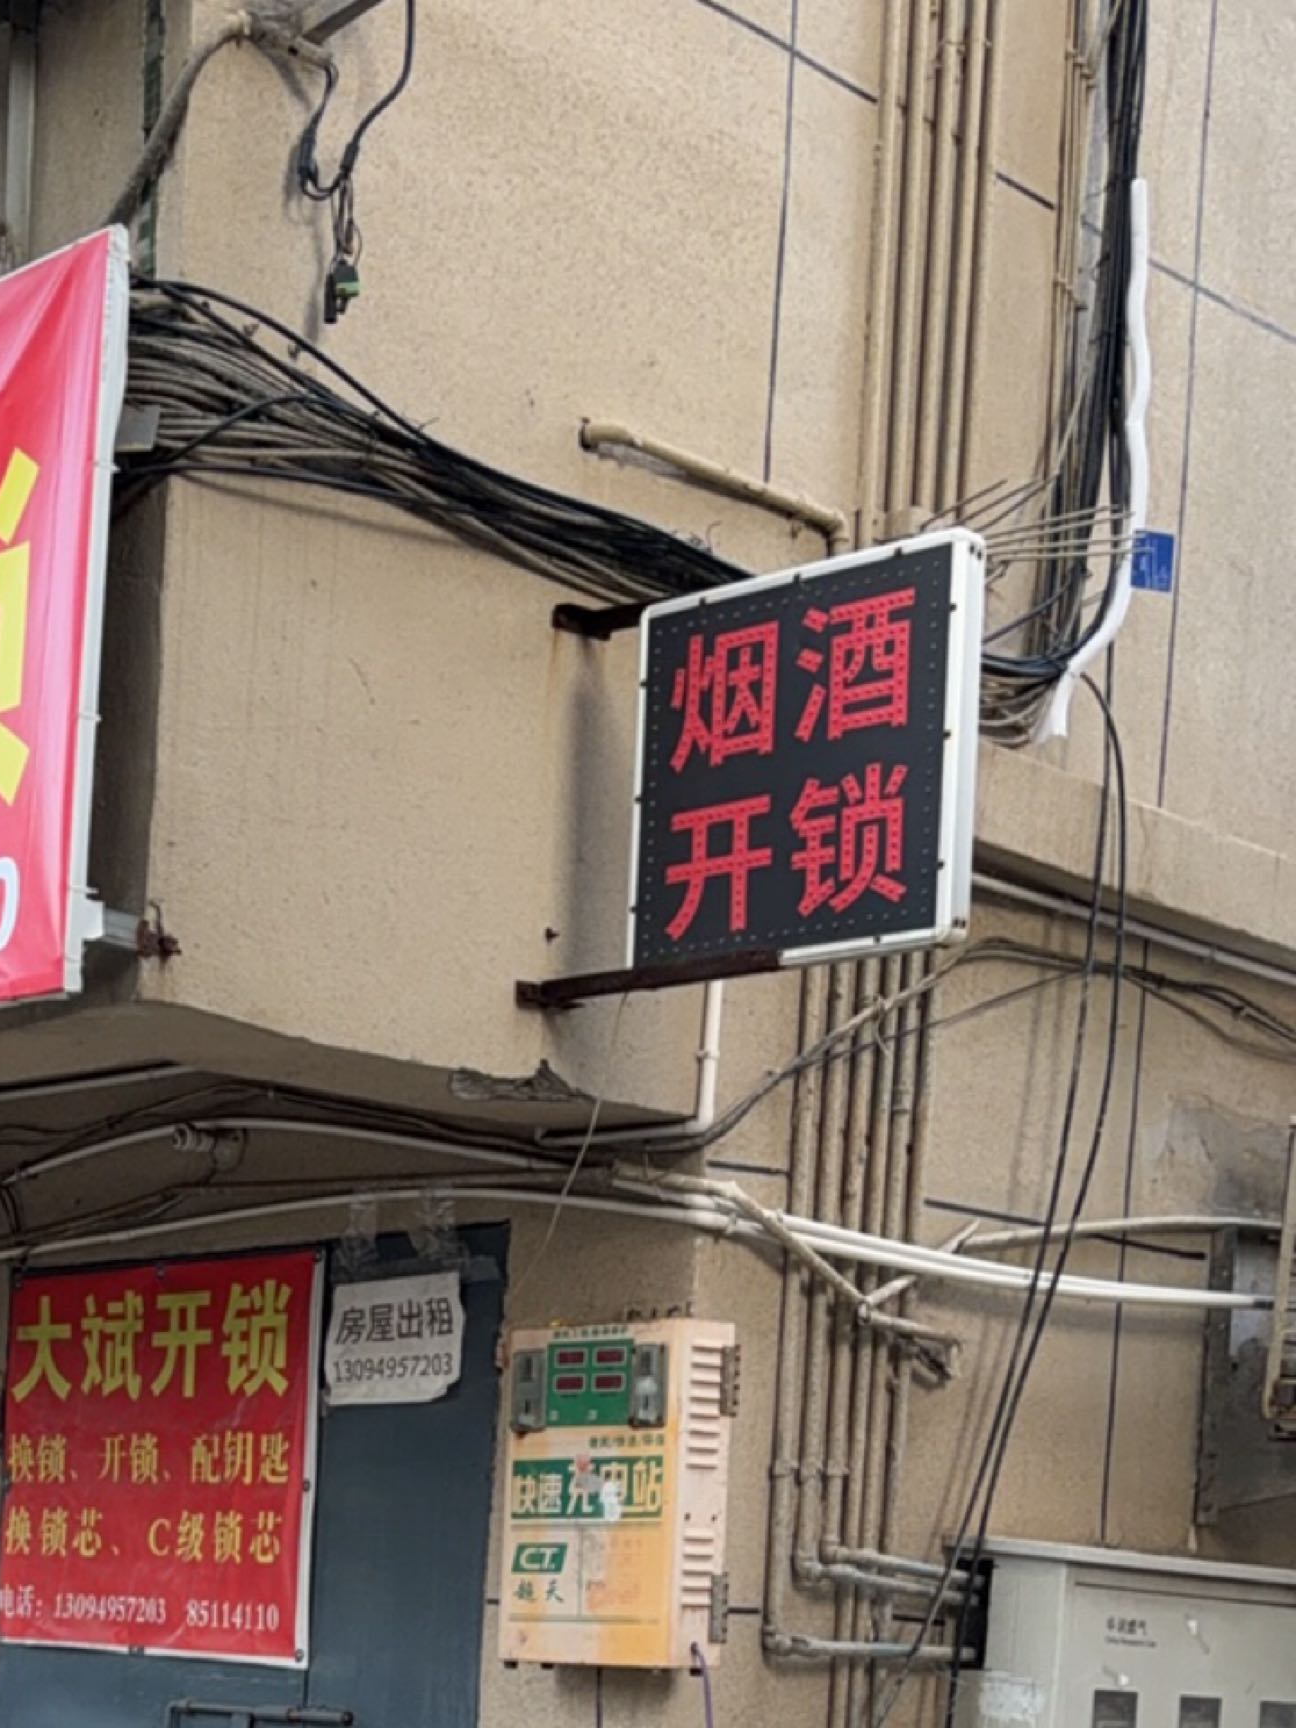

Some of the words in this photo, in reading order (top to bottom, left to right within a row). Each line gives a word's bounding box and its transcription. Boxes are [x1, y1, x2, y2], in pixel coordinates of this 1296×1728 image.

[670, 587, 916, 773] 烟酒
[665, 763, 908, 941] 开锁
[12, 1280, 293, 1401] 大斌开锁
[335, 1297, 454, 1345] 房屋出租
[333, 1352, 453, 1383] 13094957203
[186, 1598, 280, 1630] 85114110
